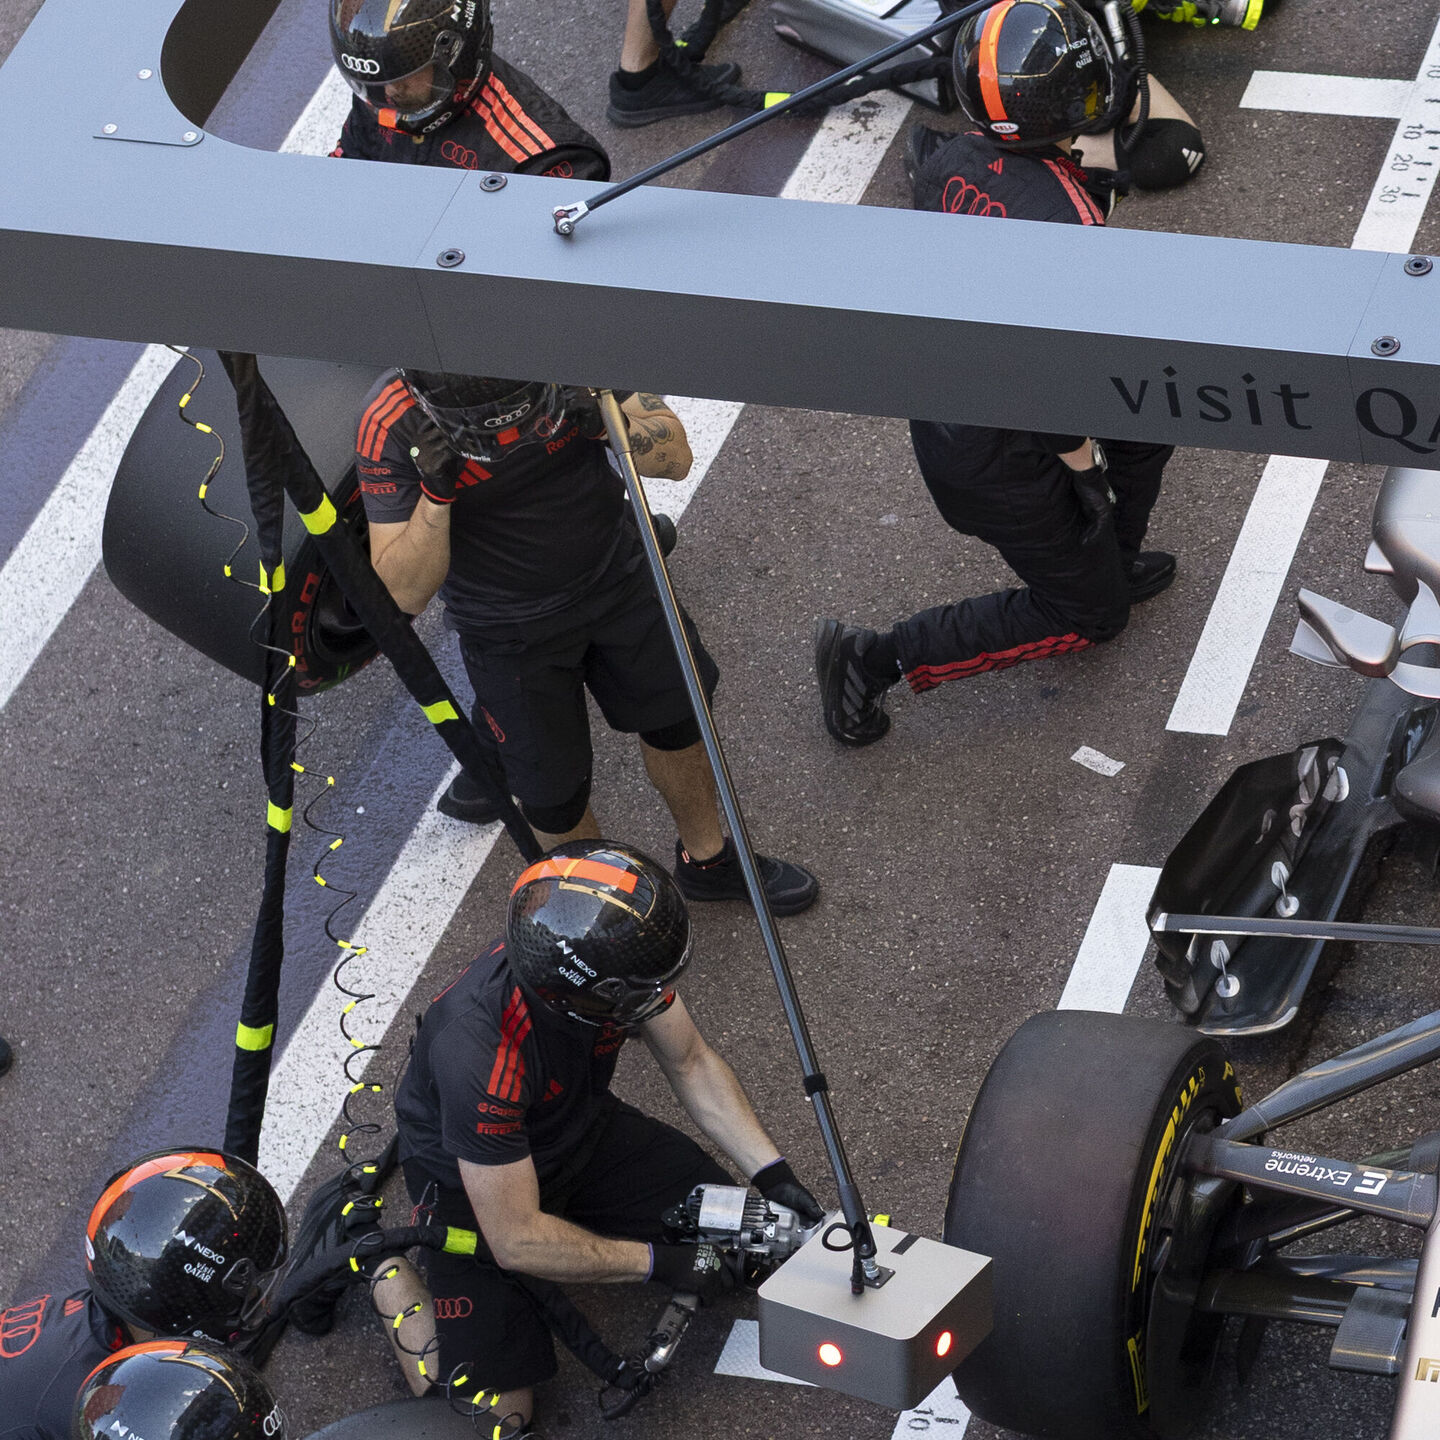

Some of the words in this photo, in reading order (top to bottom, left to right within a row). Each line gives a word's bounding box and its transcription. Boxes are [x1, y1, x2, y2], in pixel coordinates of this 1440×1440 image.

[1402, 124, 1424, 140] 10
[1391, 153, 1412, 172] 20
[1379, 185, 1400, 203] 30
[1109, 365, 1313, 431] visit
[570, 954, 598, 977] NEXO
[1270, 1150, 1317, 1164] networks
[1264, 1159, 1352, 1186] Extreme
[193, 1242, 226, 1265] NEXO
[908, 1406, 935, 1430] 10
